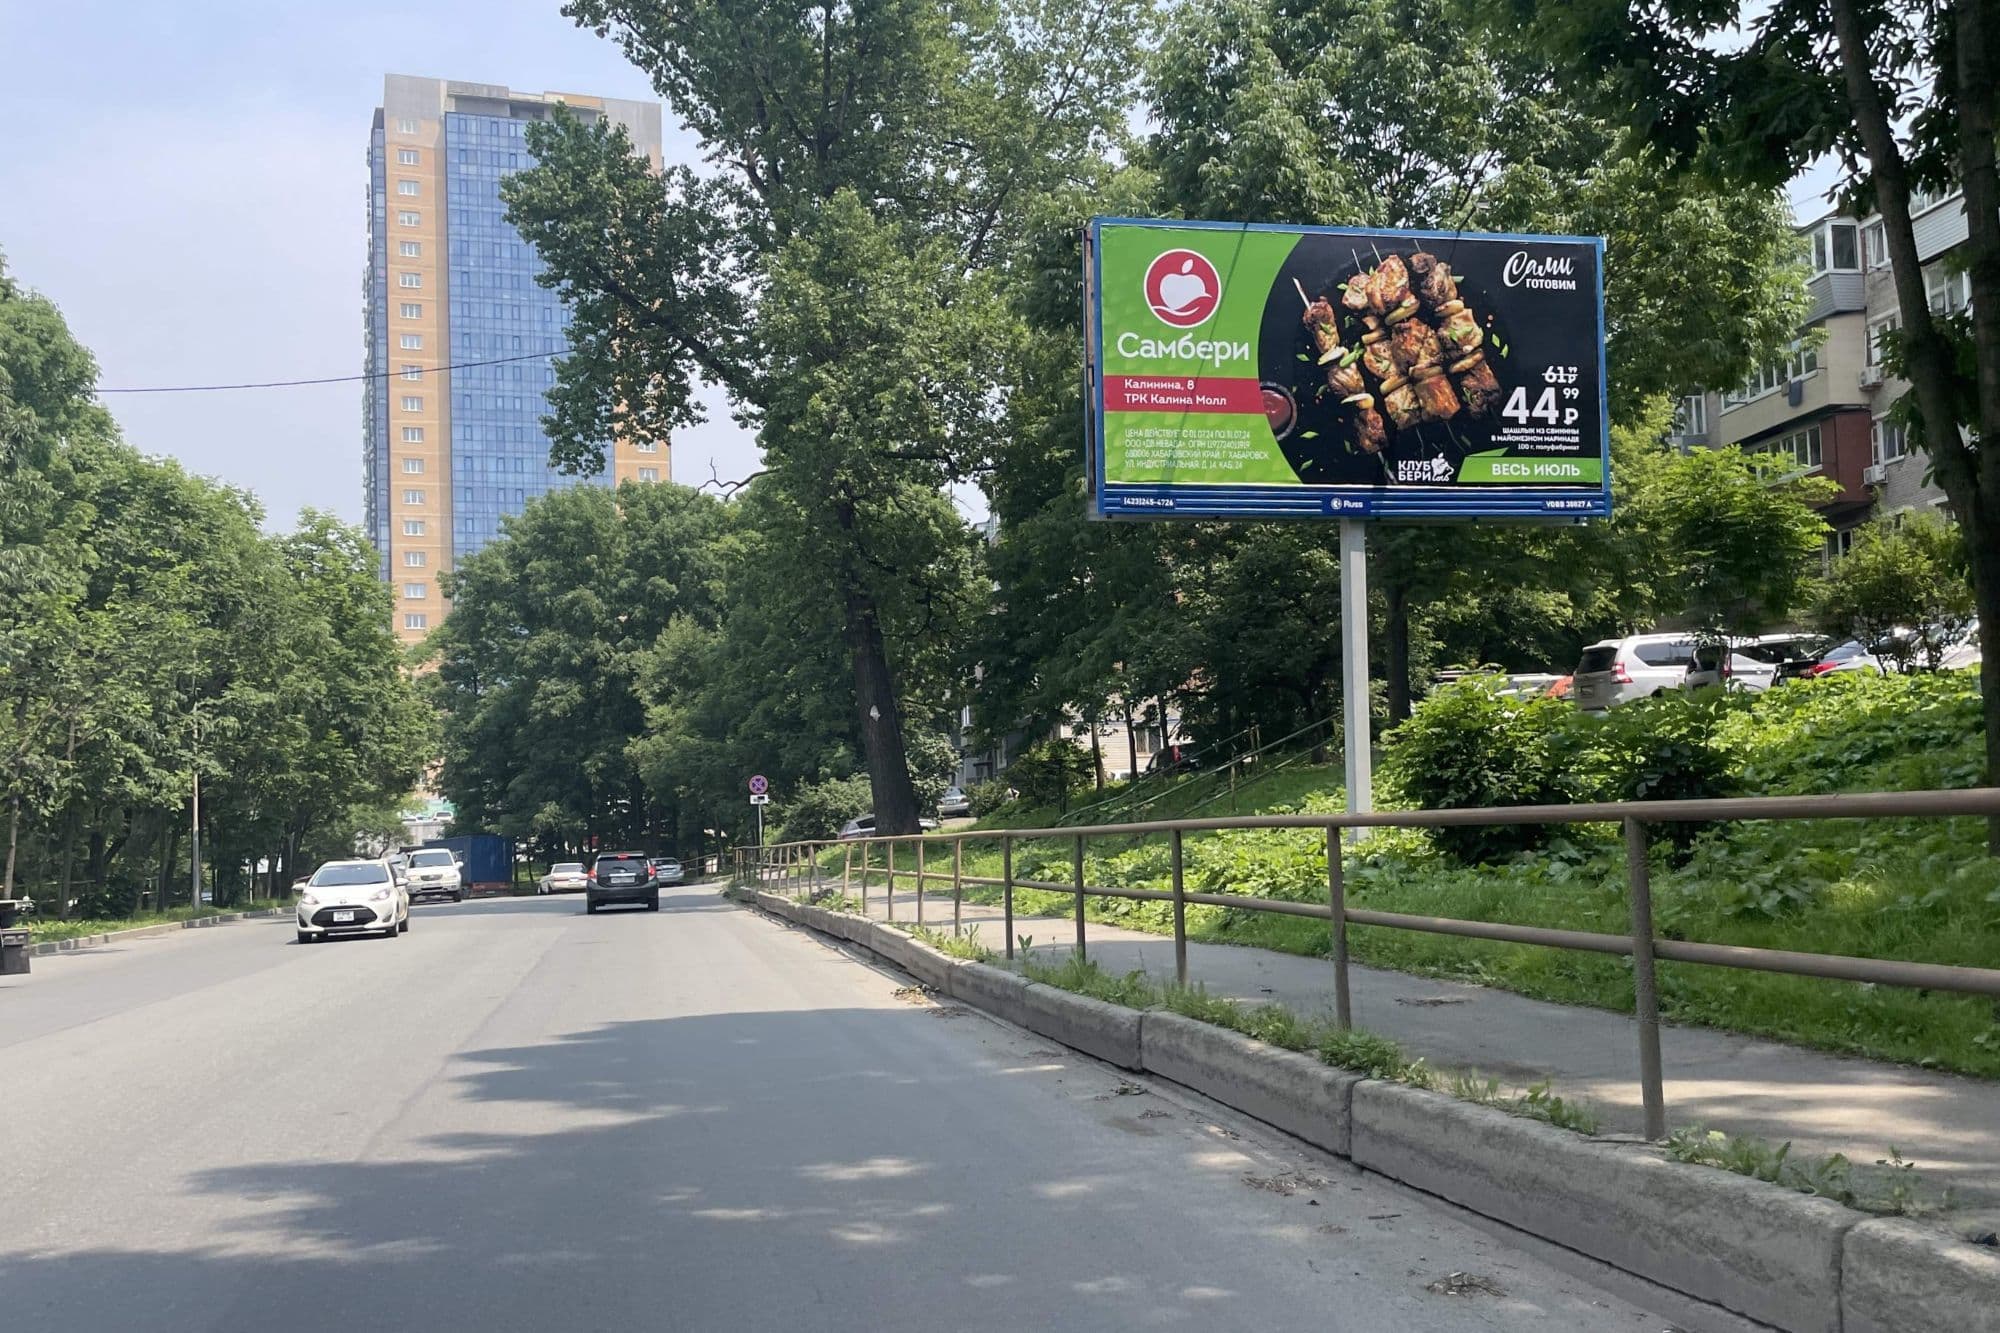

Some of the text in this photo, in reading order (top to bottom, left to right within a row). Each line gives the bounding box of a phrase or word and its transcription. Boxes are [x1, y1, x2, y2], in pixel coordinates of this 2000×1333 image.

[1503, 251, 1574, 287] Сами
[1117, 332, 1249, 367] Самбери
[1124, 379, 1195, 390] Калинина, 8
[1124, 393, 1227, 405] ТРК Калина Молл
[1502, 386, 1560, 425] 44
[1563, 387, 1580, 400] 99
[1398, 460, 1431, 471] КЛУБ
[1492, 463, 1581, 476] ВЕСЬ ИЮЛЬ
[1398, 471, 1431, 481] БЕРИ
